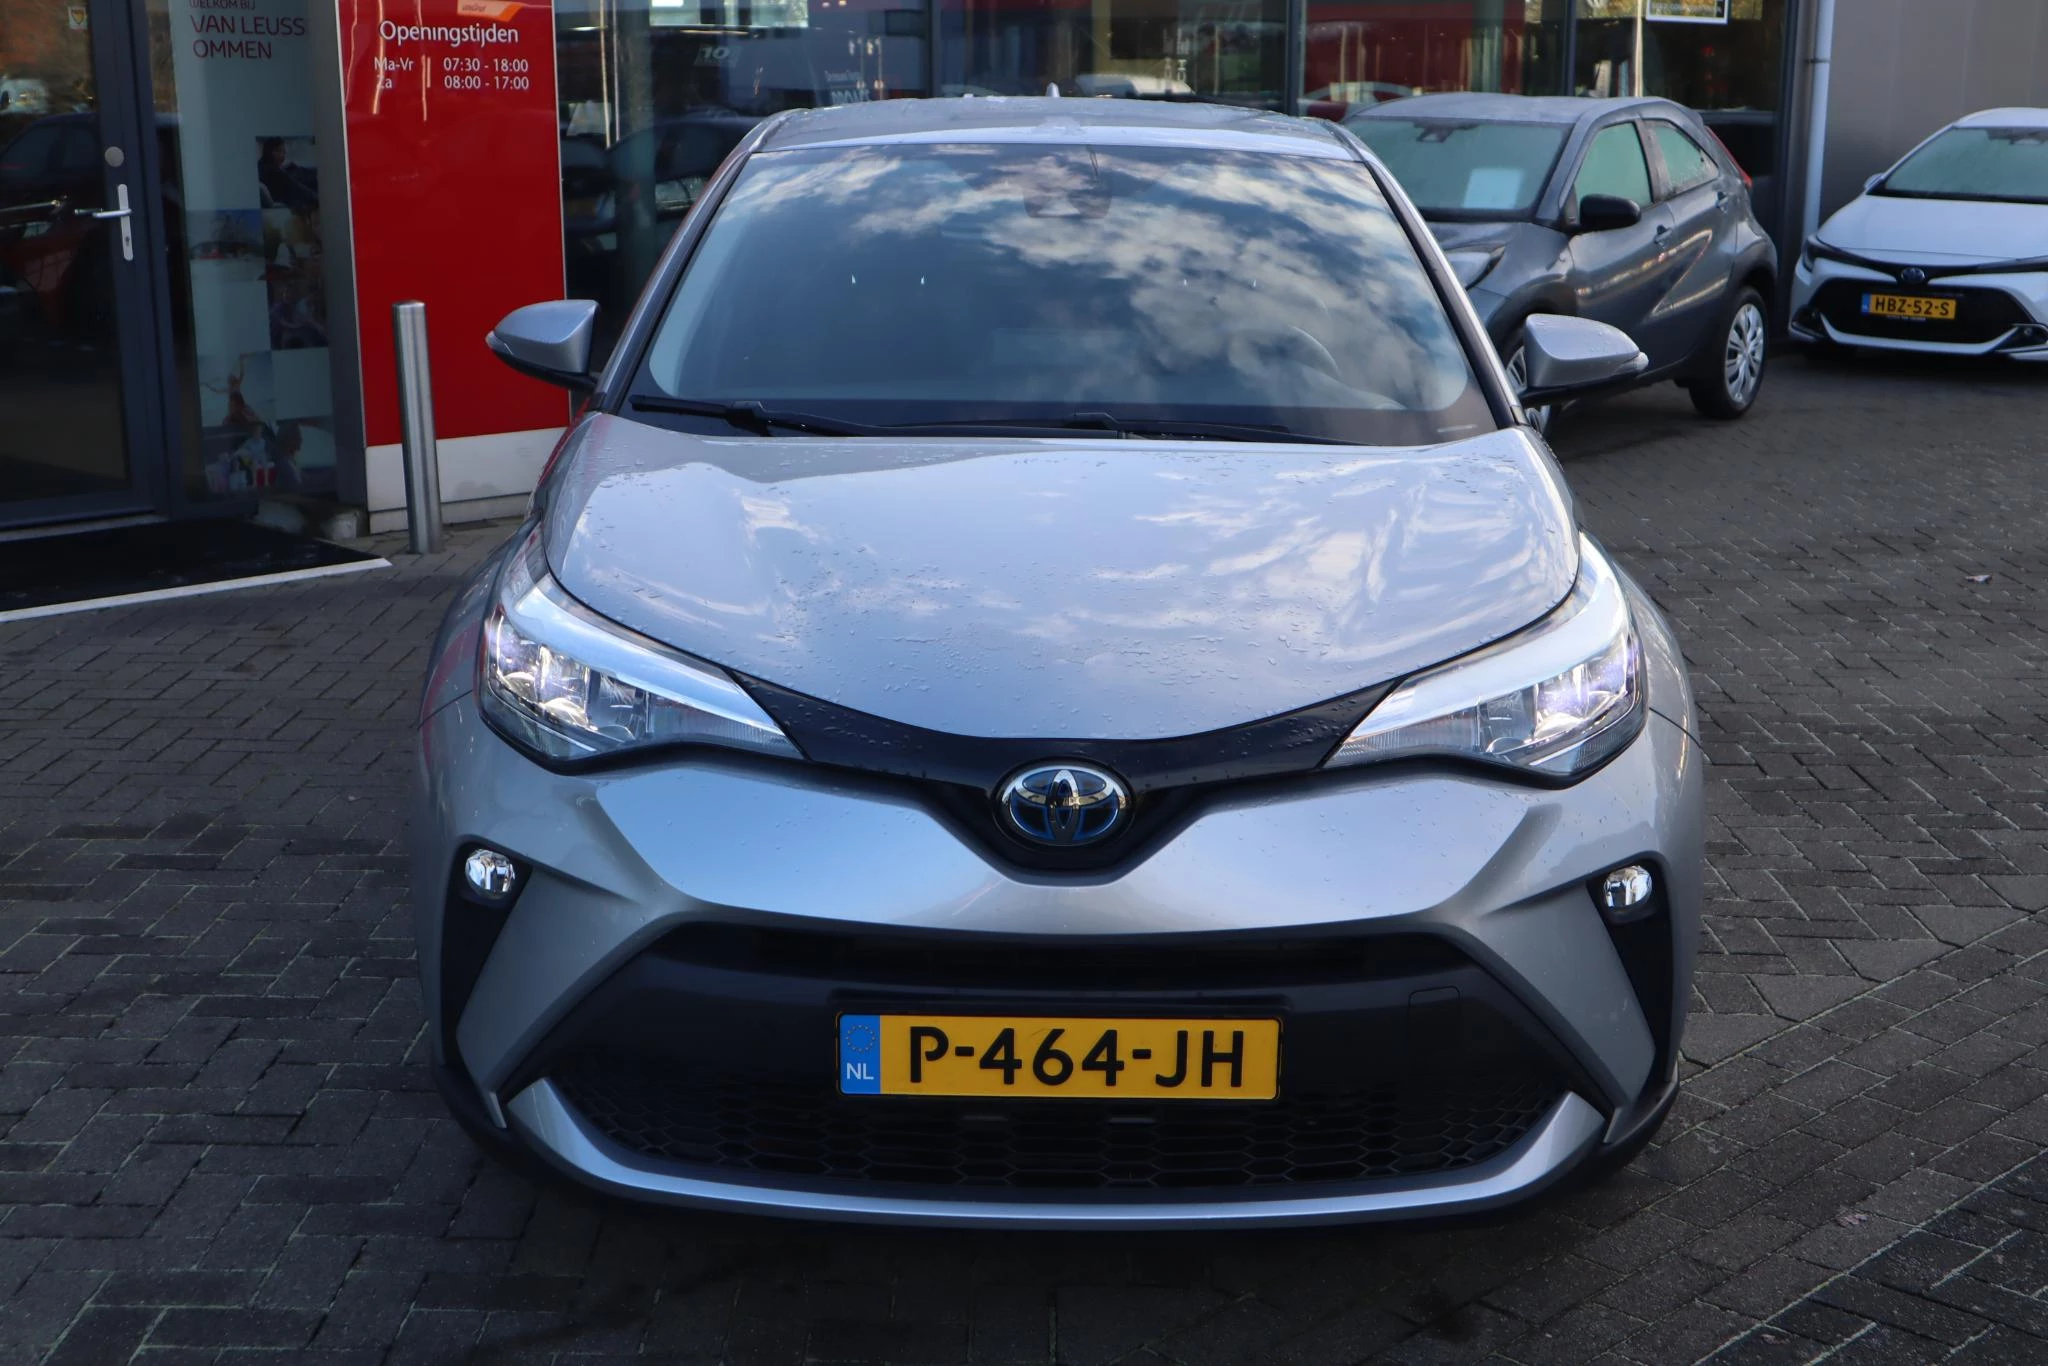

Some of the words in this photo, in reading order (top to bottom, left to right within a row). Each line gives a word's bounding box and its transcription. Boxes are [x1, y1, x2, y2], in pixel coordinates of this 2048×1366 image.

[190, 15, 235, 33] VAN
[380, 20, 519, 48] Openingstijden
[193, 39, 272, 58] OMMEN
[374, 57, 414, 71] Ma-Vr
[443, 57, 480, 71] 07:30
[494, 58, 529, 72] 18:00
[444, 75, 481, 89] 08:00
[494, 76, 530, 90] 17:00
[1875, 297, 1950, 317] HBZ-52-S
[909, 1026, 1244, 1088] P-464-JH
[846, 1063, 874, 1081] NL
